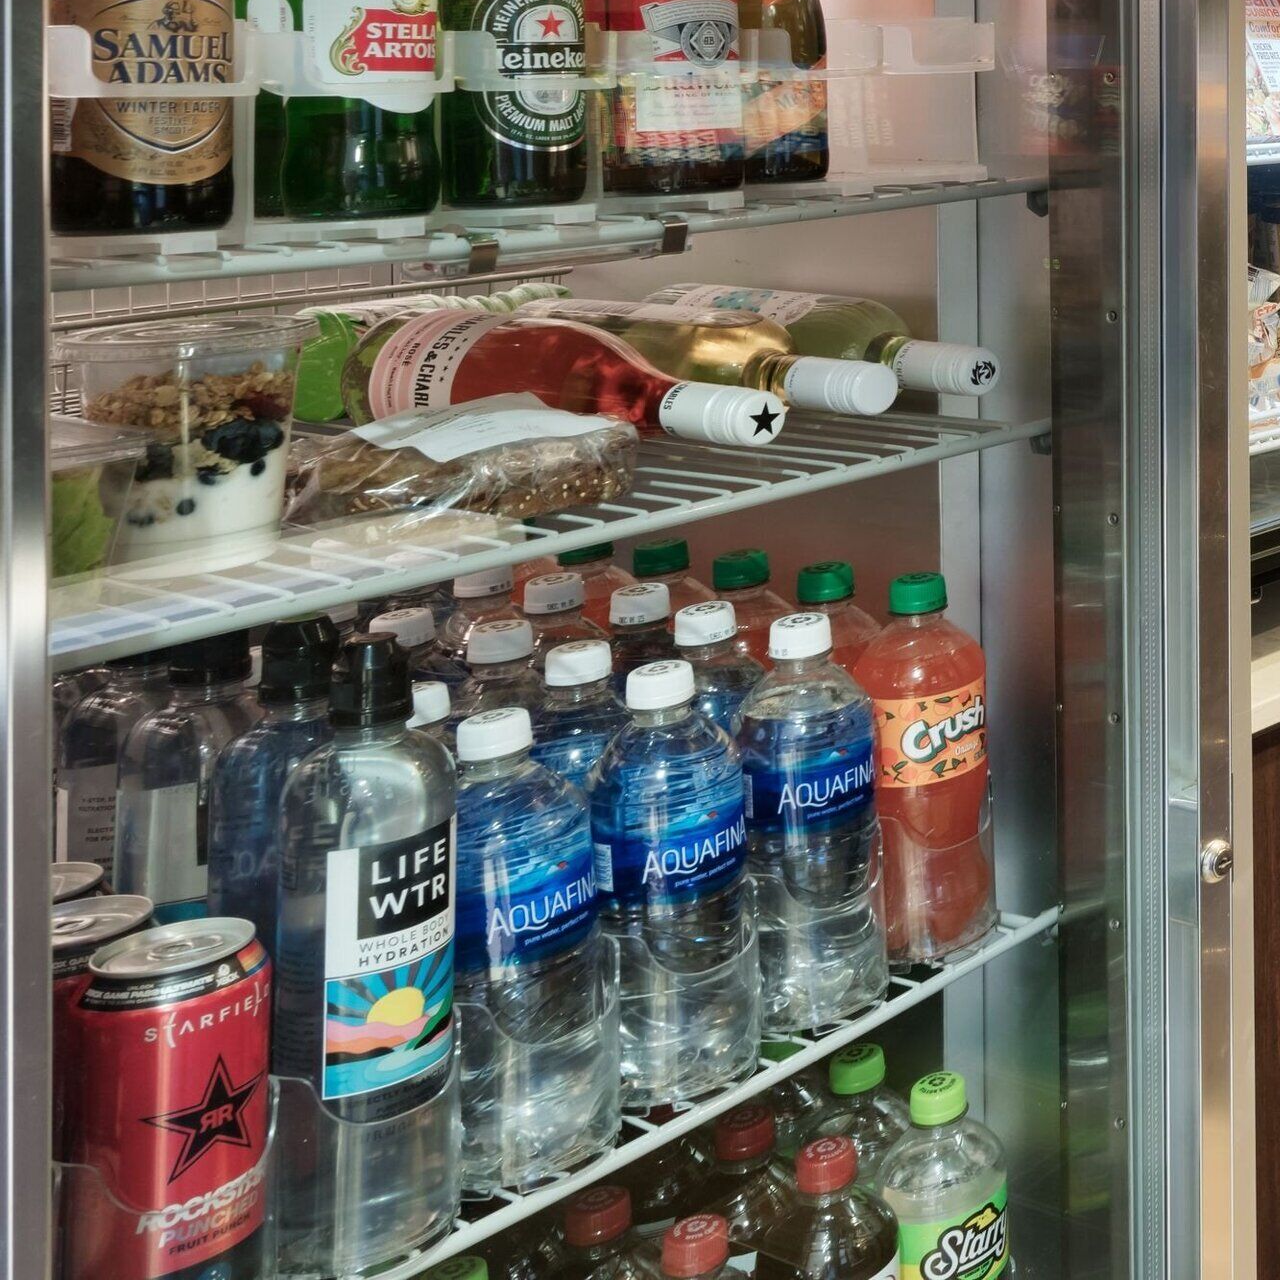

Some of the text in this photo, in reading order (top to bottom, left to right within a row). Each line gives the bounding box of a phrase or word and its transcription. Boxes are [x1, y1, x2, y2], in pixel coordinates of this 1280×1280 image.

[93, 28, 232, 62] SAMUEL
[366, 22, 437, 40] STELLA
[109, 61, 227, 84] ADAMS
[116, 101, 221, 114] WINTER LAGER
[495, 95, 574, 132] PREMIUM MALT
[663, 383, 689, 411] CHARLES
[901, 695, 985, 762] Crush
[777, 754, 875, 815] AQUAFINA
[371, 837, 446, 886] LIFE
[641, 813, 748, 886] AQUAFINA
[369, 873, 446, 920] WTR
[675, 877, 690, 888] pure
[487, 871, 600, 946] AQUAFINA
[358, 926, 450, 968] HYDRATION
[359, 913, 450, 954] WHOLE BODY
[524, 926, 561, 947] pure water,
[103, 991, 130, 1000] GAME
[130, 988, 159, 999] PASS
[160, 974, 215, 995] ULTIMATE
[215, 972, 241, 988] XBOX
[169, 1213, 251, 1255] FRUIT PUNCH
